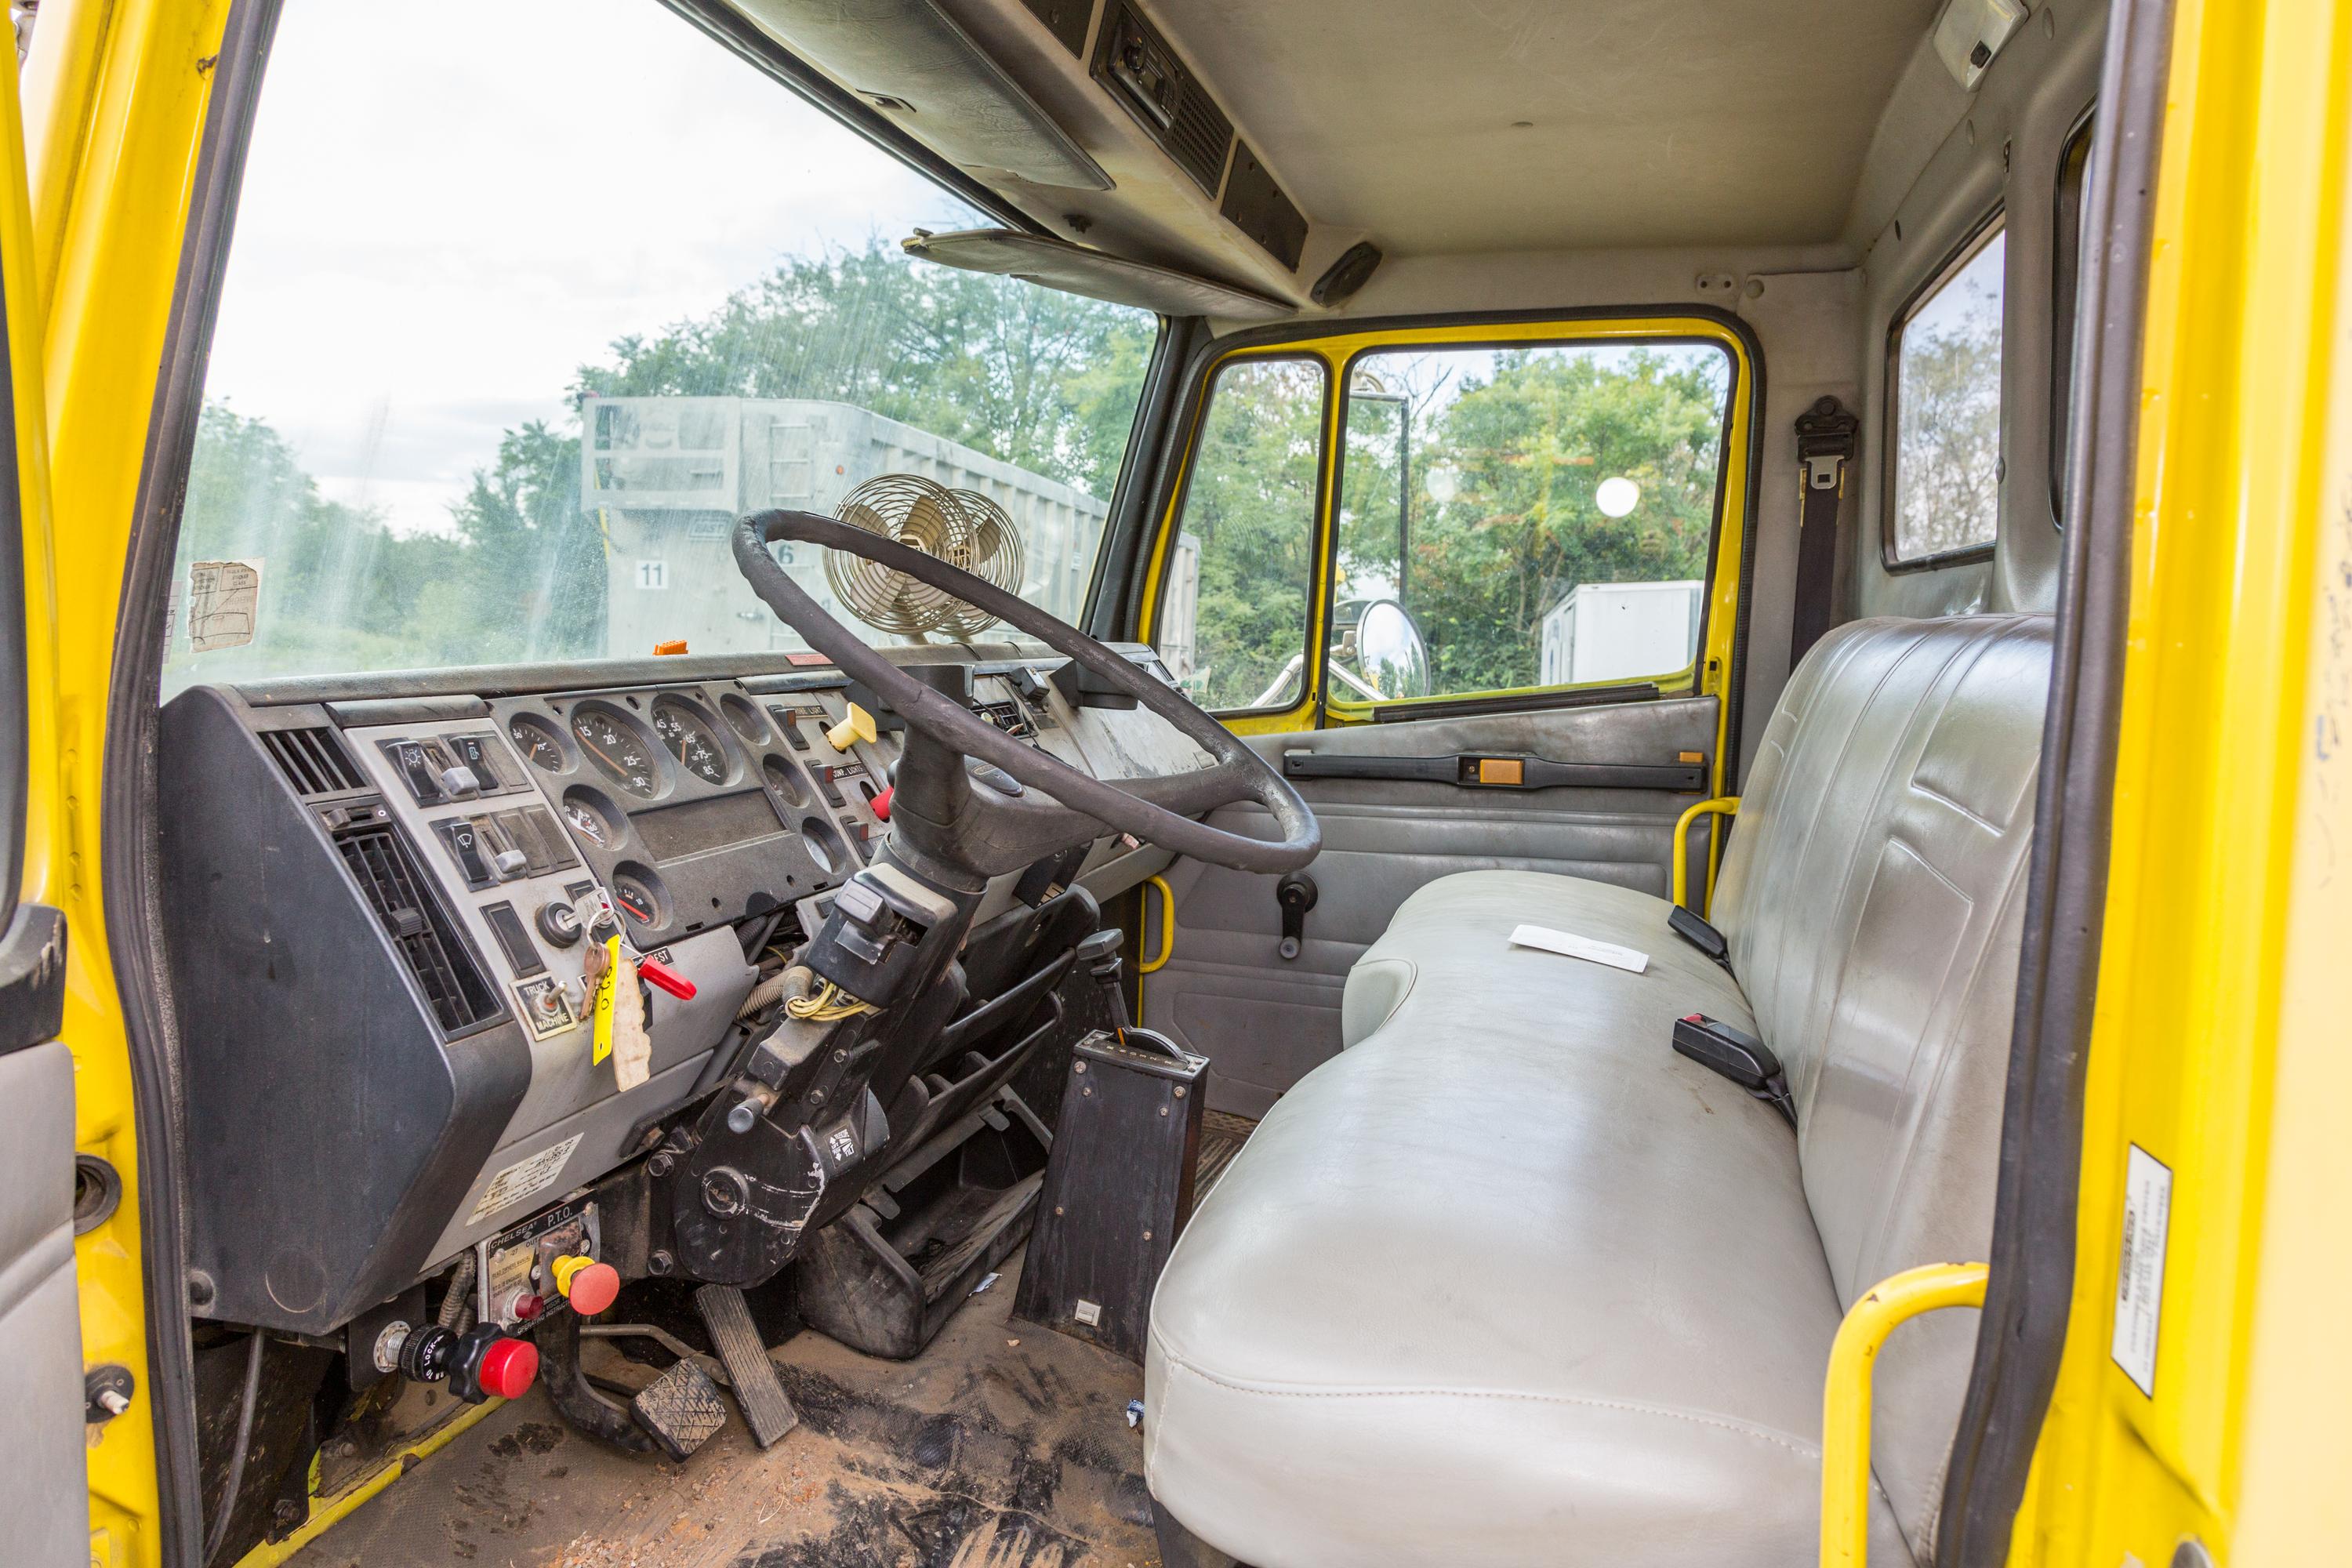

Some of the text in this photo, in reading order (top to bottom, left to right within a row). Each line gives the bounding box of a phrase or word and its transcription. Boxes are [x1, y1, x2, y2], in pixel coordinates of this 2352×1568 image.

[641, 563, 662, 586] 11
[657, 719, 667, 729] 45
[670, 722, 681, 732] 55
[579, 726, 592, 736] 15
[603, 734, 617, 745] 20
[685, 735, 695, 743] 65
[624, 756, 637, 766] 25
[702, 765, 714, 775] 85
[633, 776, 645, 786] 30
[524, 981, 550, 996] TRUCK
[535, 1012, 569, 1031] MACHINE
[547, 1206, 572, 1228] P.T.O.
[517, 1314, 546, 1334] OPERATING
[424, 1342, 436, 1367] LOCK
[426, 1369, 434, 1380] TO
